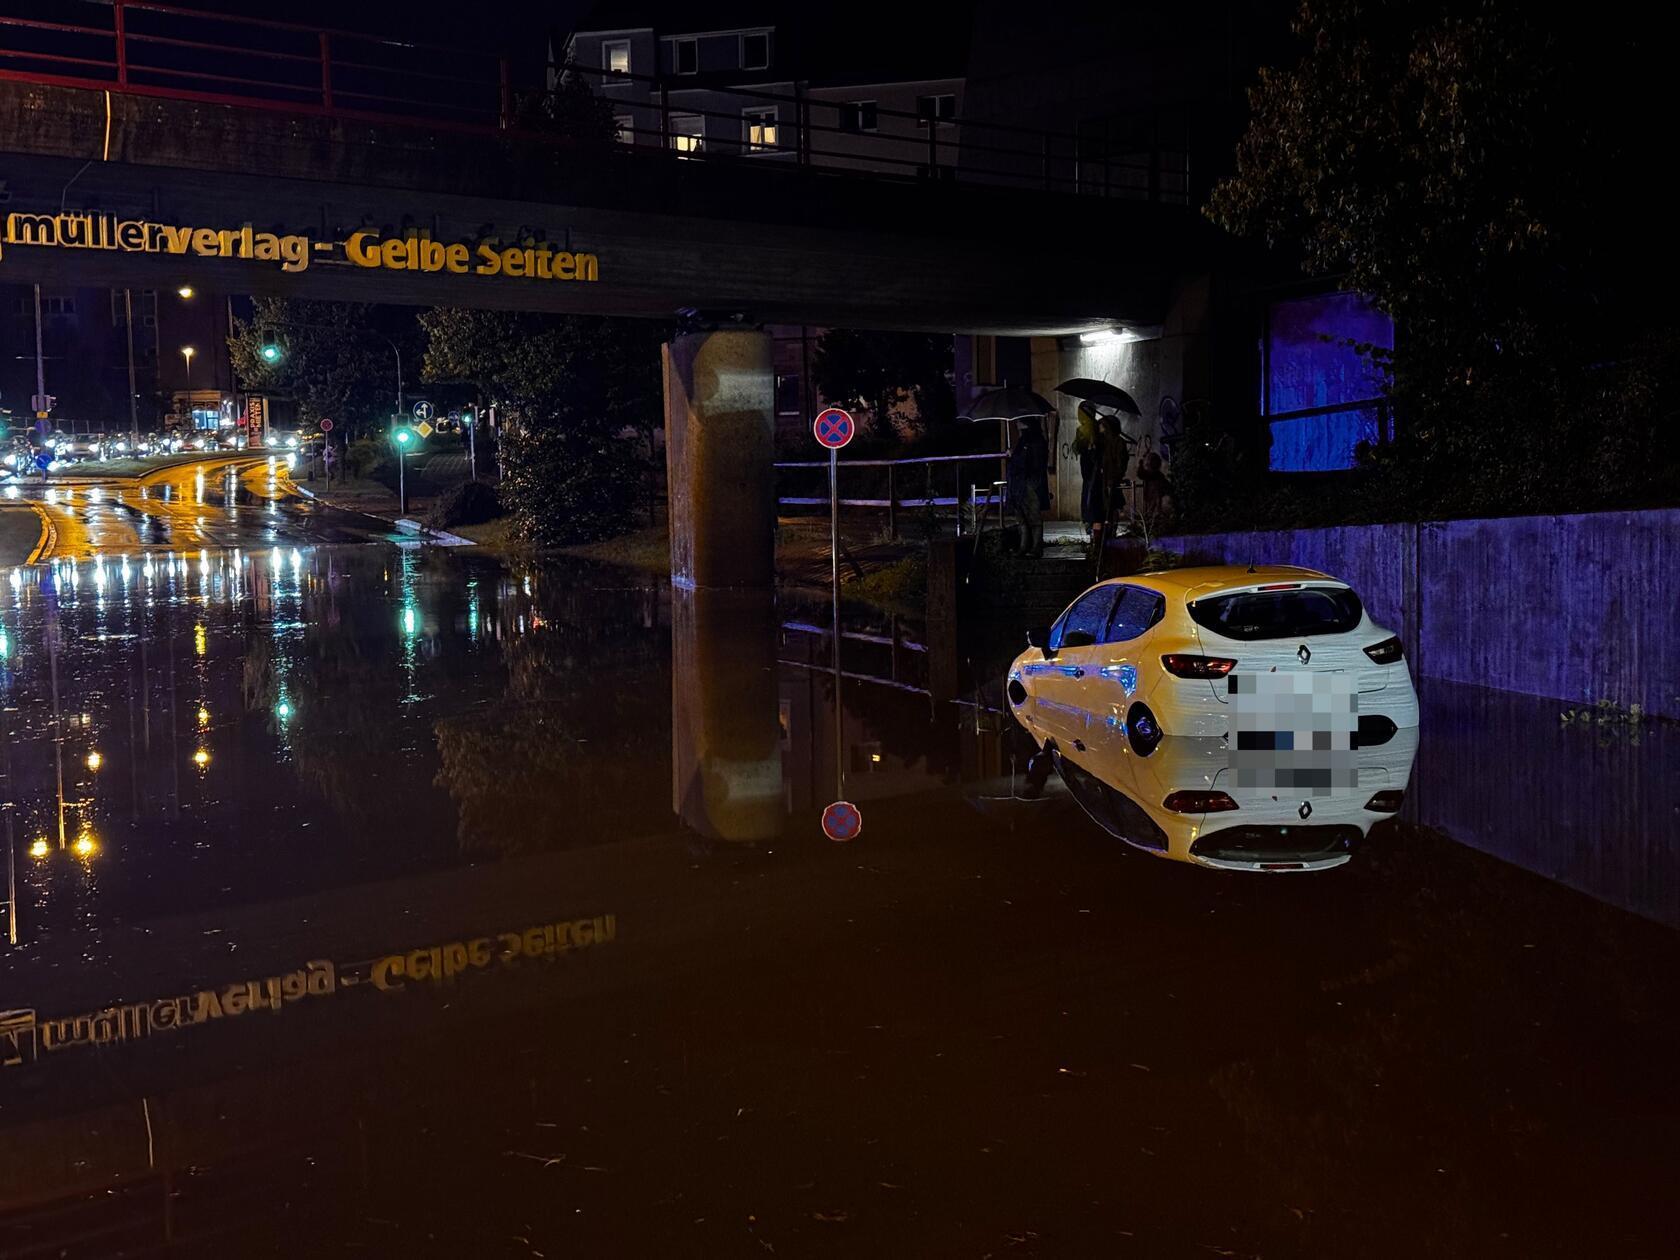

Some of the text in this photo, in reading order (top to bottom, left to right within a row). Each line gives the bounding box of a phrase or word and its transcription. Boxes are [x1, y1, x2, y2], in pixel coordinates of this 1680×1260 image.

[7, 209, 310, 272] müllerverlag
[346, 227, 470, 273] Gelbe
[476, 236, 599, 281] Seiten
